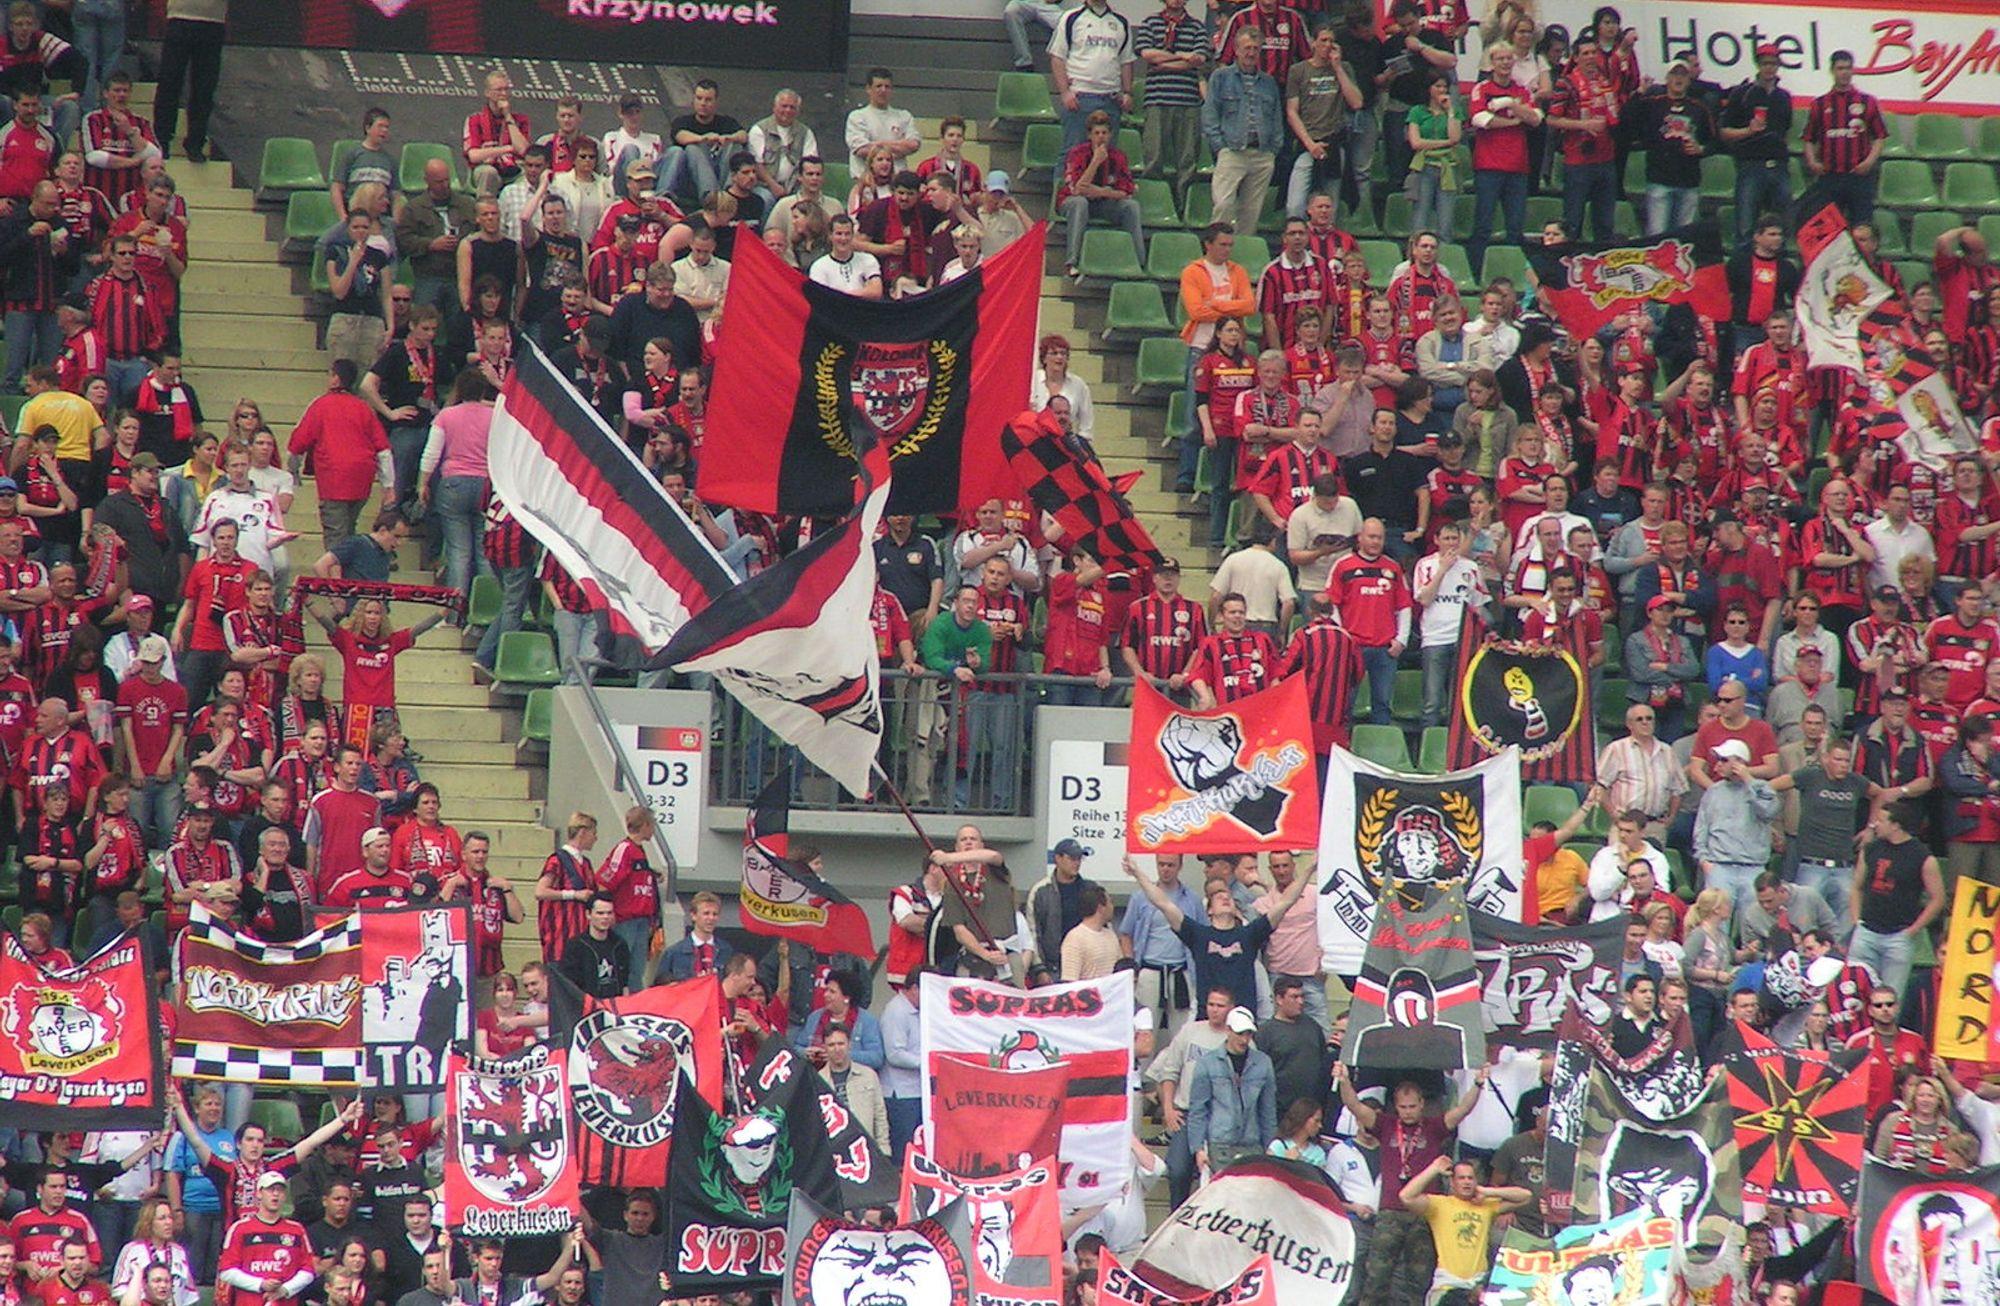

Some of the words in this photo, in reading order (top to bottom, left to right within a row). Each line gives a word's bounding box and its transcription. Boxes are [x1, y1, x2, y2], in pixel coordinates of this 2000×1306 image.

[567, 0, 778, 25] Krzynowek
[1660, 17, 1819, 72] Hotel
[1853, 18, 2000, 101] BayAr
[1150, 635, 1178, 648] RWE
[648, 760, 689, 787] D3
[1060, 774, 1101, 802] D3
[1072, 809, 1110, 822] Reihe
[1072, 826, 1106, 839] Sitze
[1956, 885, 2000, 1045] NORD
[948, 985, 1104, 1018] SUPRAS
[944, 1090, 1062, 1112] LEVERKUSEN
[464, 1203, 570, 1237] Leverkusen
[680, 1223, 788, 1277] SUPR
[1176, 1203, 1354, 1285] Leverkusen
[250, 1260, 282, 1273] RWE
